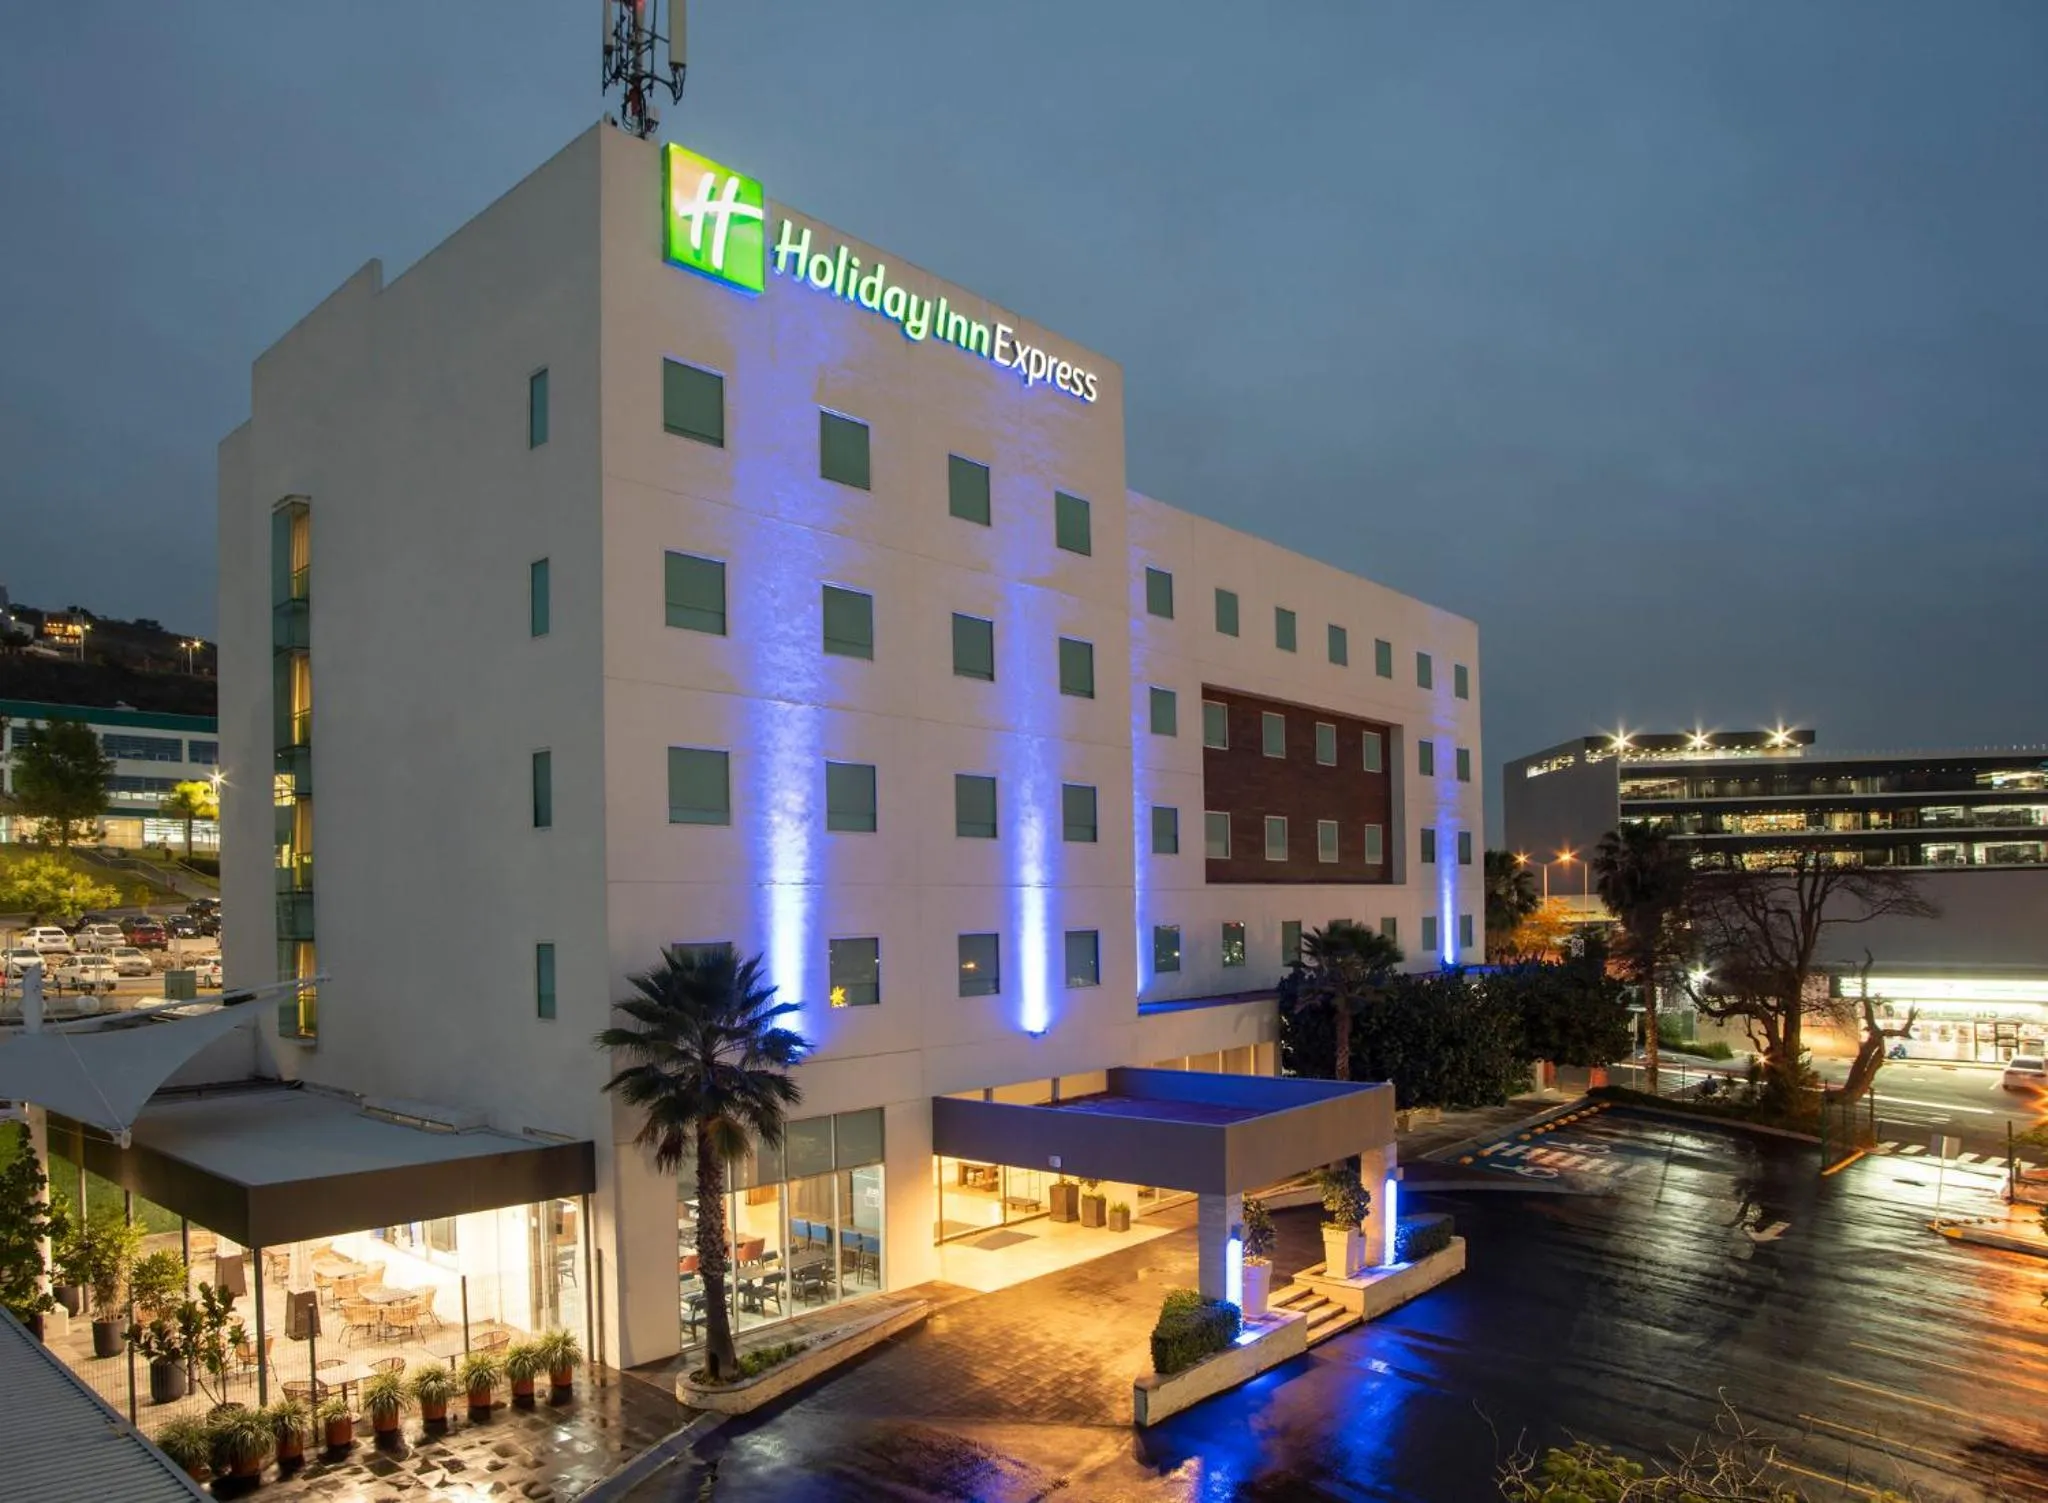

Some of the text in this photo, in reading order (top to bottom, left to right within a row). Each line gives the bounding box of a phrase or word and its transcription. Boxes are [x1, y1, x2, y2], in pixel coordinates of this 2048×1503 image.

[678, 172, 764, 269] H
[775, 219, 1098, 403] Holiday Inn Express
